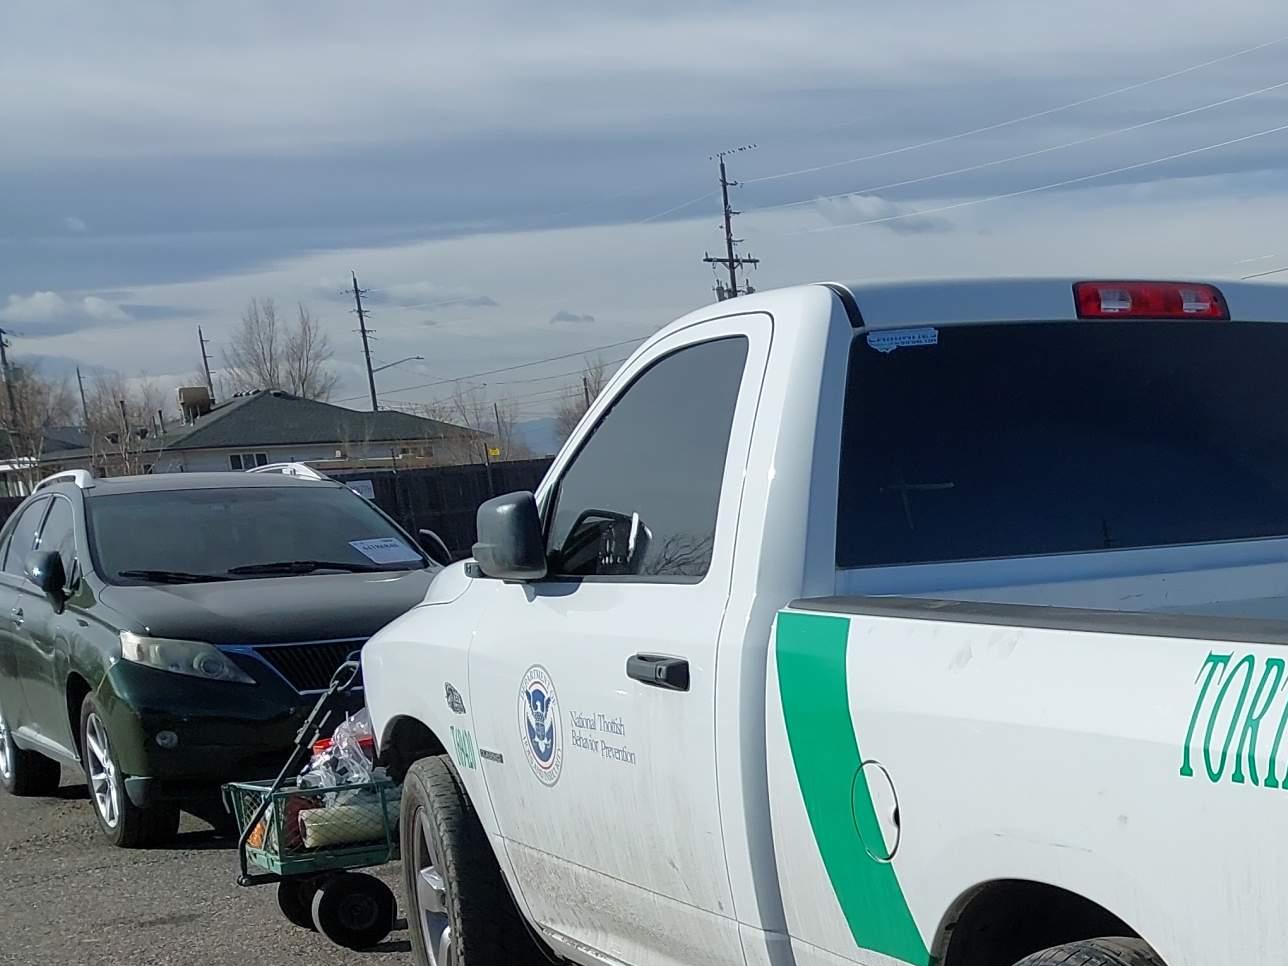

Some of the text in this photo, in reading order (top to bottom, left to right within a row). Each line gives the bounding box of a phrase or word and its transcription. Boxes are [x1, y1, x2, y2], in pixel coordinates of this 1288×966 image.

[569, 711, 626, 736] National Thottish
[572, 729, 636, 765] Behavior Prevention
